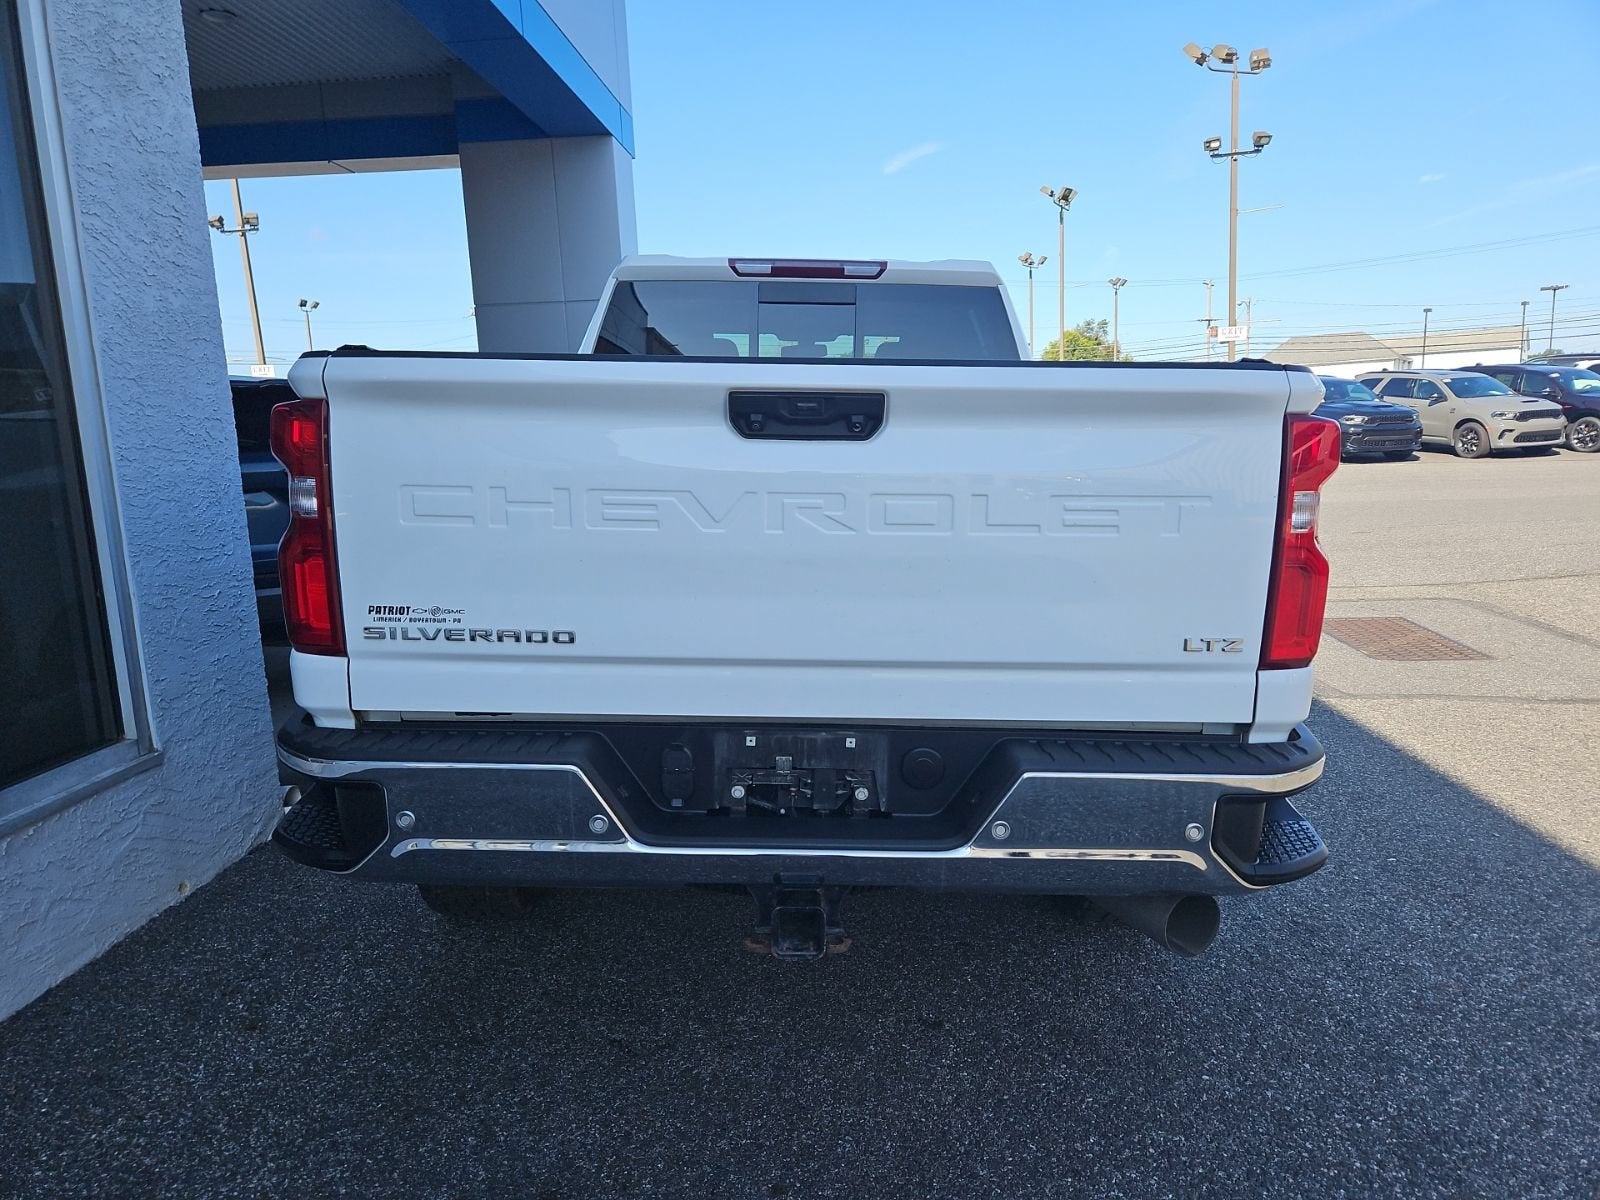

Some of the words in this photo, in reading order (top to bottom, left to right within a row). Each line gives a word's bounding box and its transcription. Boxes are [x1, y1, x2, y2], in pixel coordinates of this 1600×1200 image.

[399, 484, 1213, 536] CHEVROLET
[368, 605, 411, 616] PATRIOT
[363, 626, 576, 644] SILVERADO
[1183, 638, 1244, 653] LTZ
